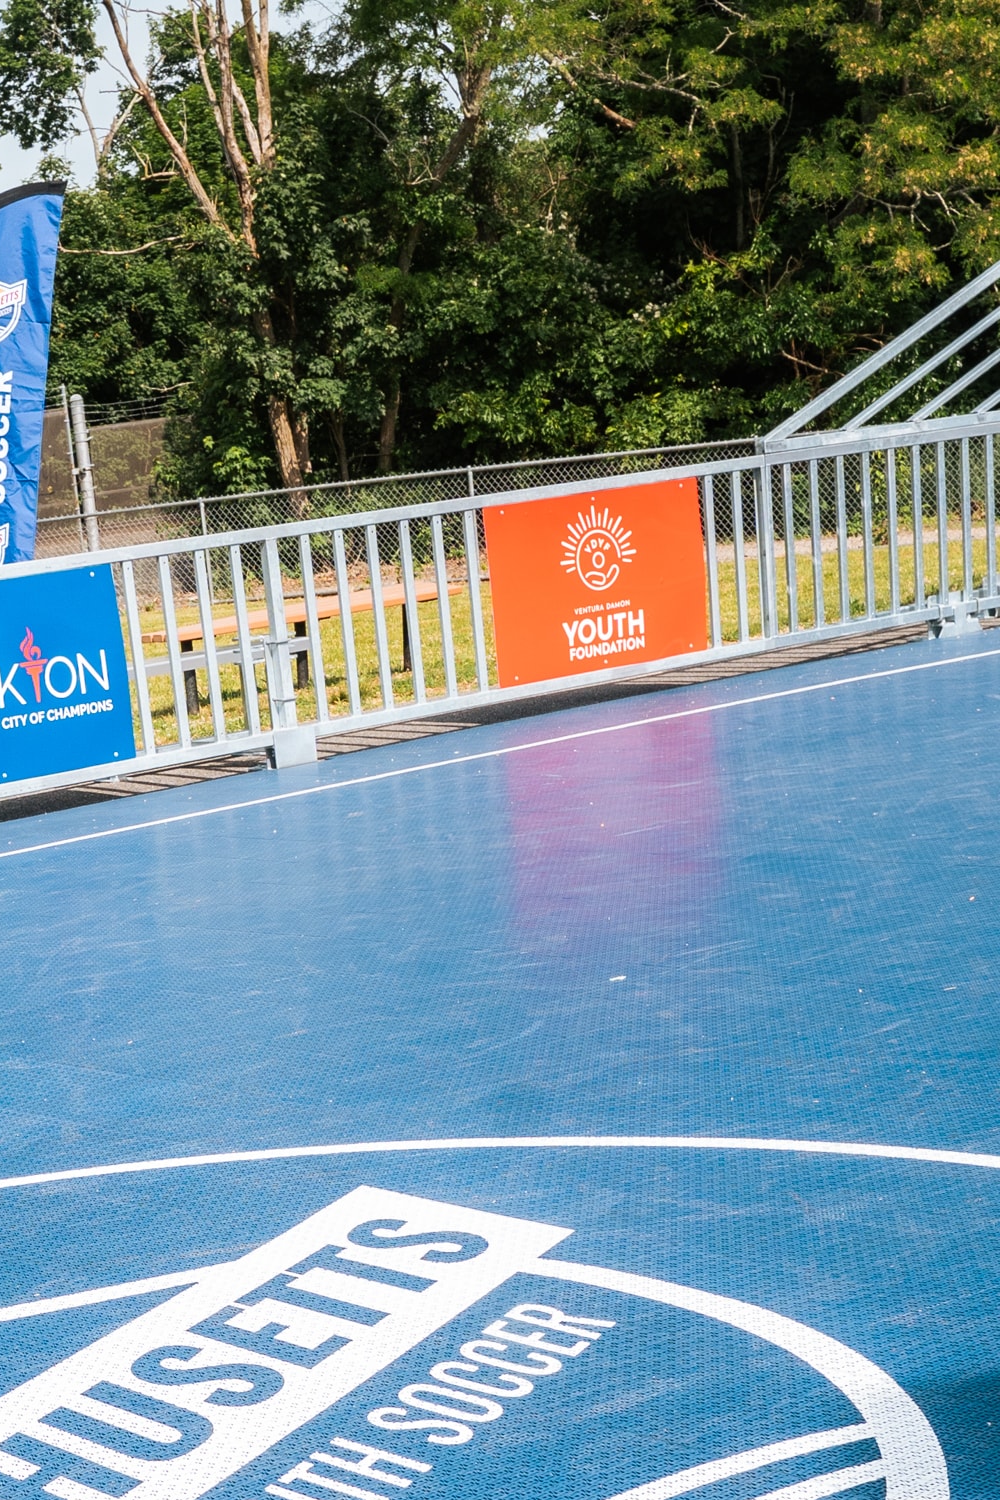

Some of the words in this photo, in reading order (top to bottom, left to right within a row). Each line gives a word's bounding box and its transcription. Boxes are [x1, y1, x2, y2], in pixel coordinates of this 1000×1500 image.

[584, 538, 611, 554] VDYF
[574, 604, 604, 615] VENTURA
[606, 599, 631, 610] DAMON
[562, 609, 645, 647] YOUTH
[569, 635, 646, 662] FOUNDATION
[1, 713, 28, 730] CITY
[28, 710, 46, 725] OF
[46, 699, 114, 722] CHAMPIONS
[366, 1303, 617, 1445] SOCCER
